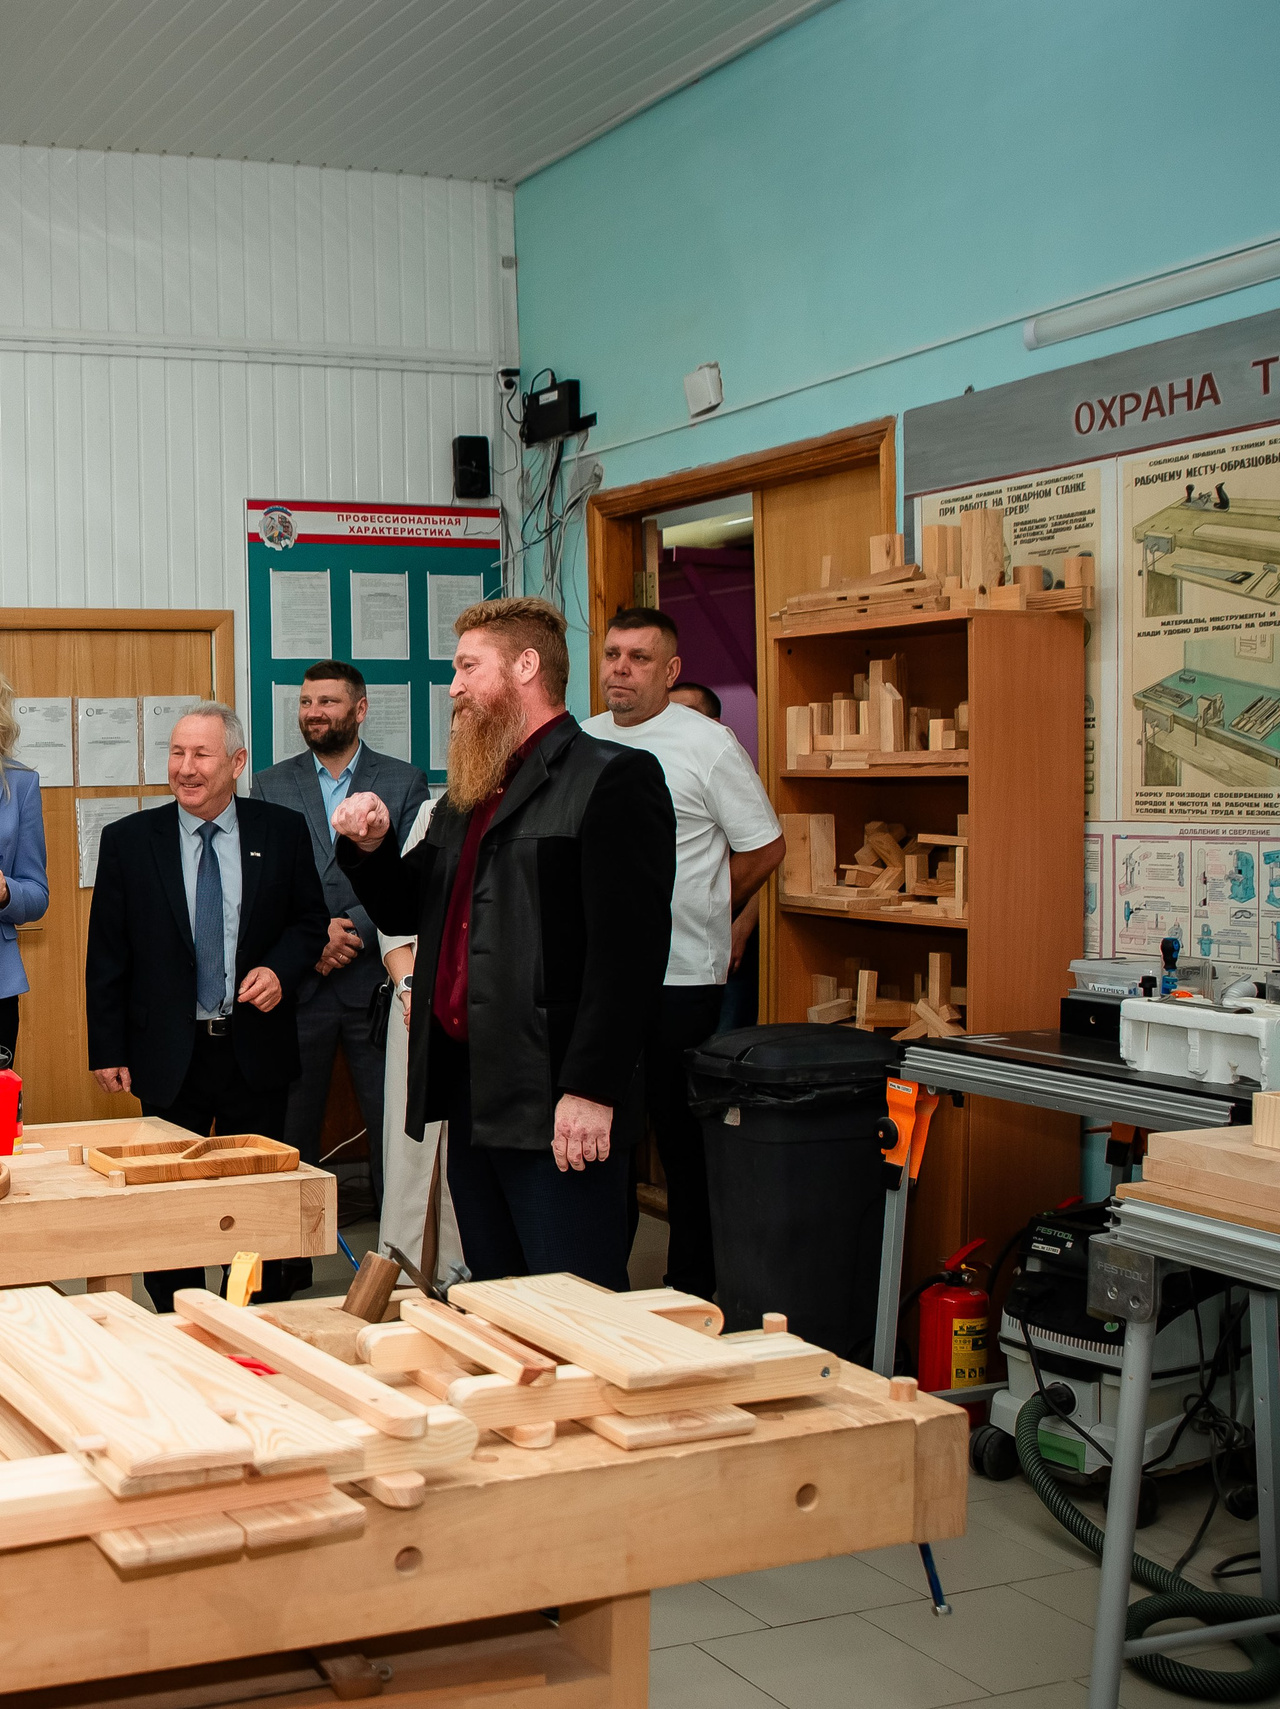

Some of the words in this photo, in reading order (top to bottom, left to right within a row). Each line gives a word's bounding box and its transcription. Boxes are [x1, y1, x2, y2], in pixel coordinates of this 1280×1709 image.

[1075, 372, 1221, 435] ОХРАНА
[1149, 454, 1189, 466] СОБЛЮДАЙ
[1192, 448, 1226, 459] ПРАВИЛА
[1231, 441, 1265, 452] ТЕХНИКИ
[1135, 469, 1182, 486] РАБОЧЕМУ
[976, 488, 1002, 498] ПРАВИЛА
[1007, 483, 1033, 492] ТЕХНИКИ
[1036, 473, 1083, 487] БЕЗОПАСНОСТИ
[939, 505, 955, 516] ПРИ
[960, 500, 988, 515] РАБОТЕ
[992, 498, 1003, 507] НА
[1007, 488, 1051, 503] ТОКАРНОМ
[1056, 481, 1086, 495] СТАНКЕ
[1004, 503, 1029, 516] ЕРЕВУ
[337, 514, 461, 526] ПРОФЕССИОНАЛЬНАЯ
[349, 526, 451, 536] ХАРАКТЕРИСТИКА
[1210, 612, 1265, 622] ИНСТРУМЕНТЫ
[1212, 623, 1242, 632] РАБОТЫ
[1091, 984, 1124, 995] Аптечка
[1036, 1226, 1074, 1241] FESTOOL
[1097, 1261, 1146, 1283] FESTOOL
